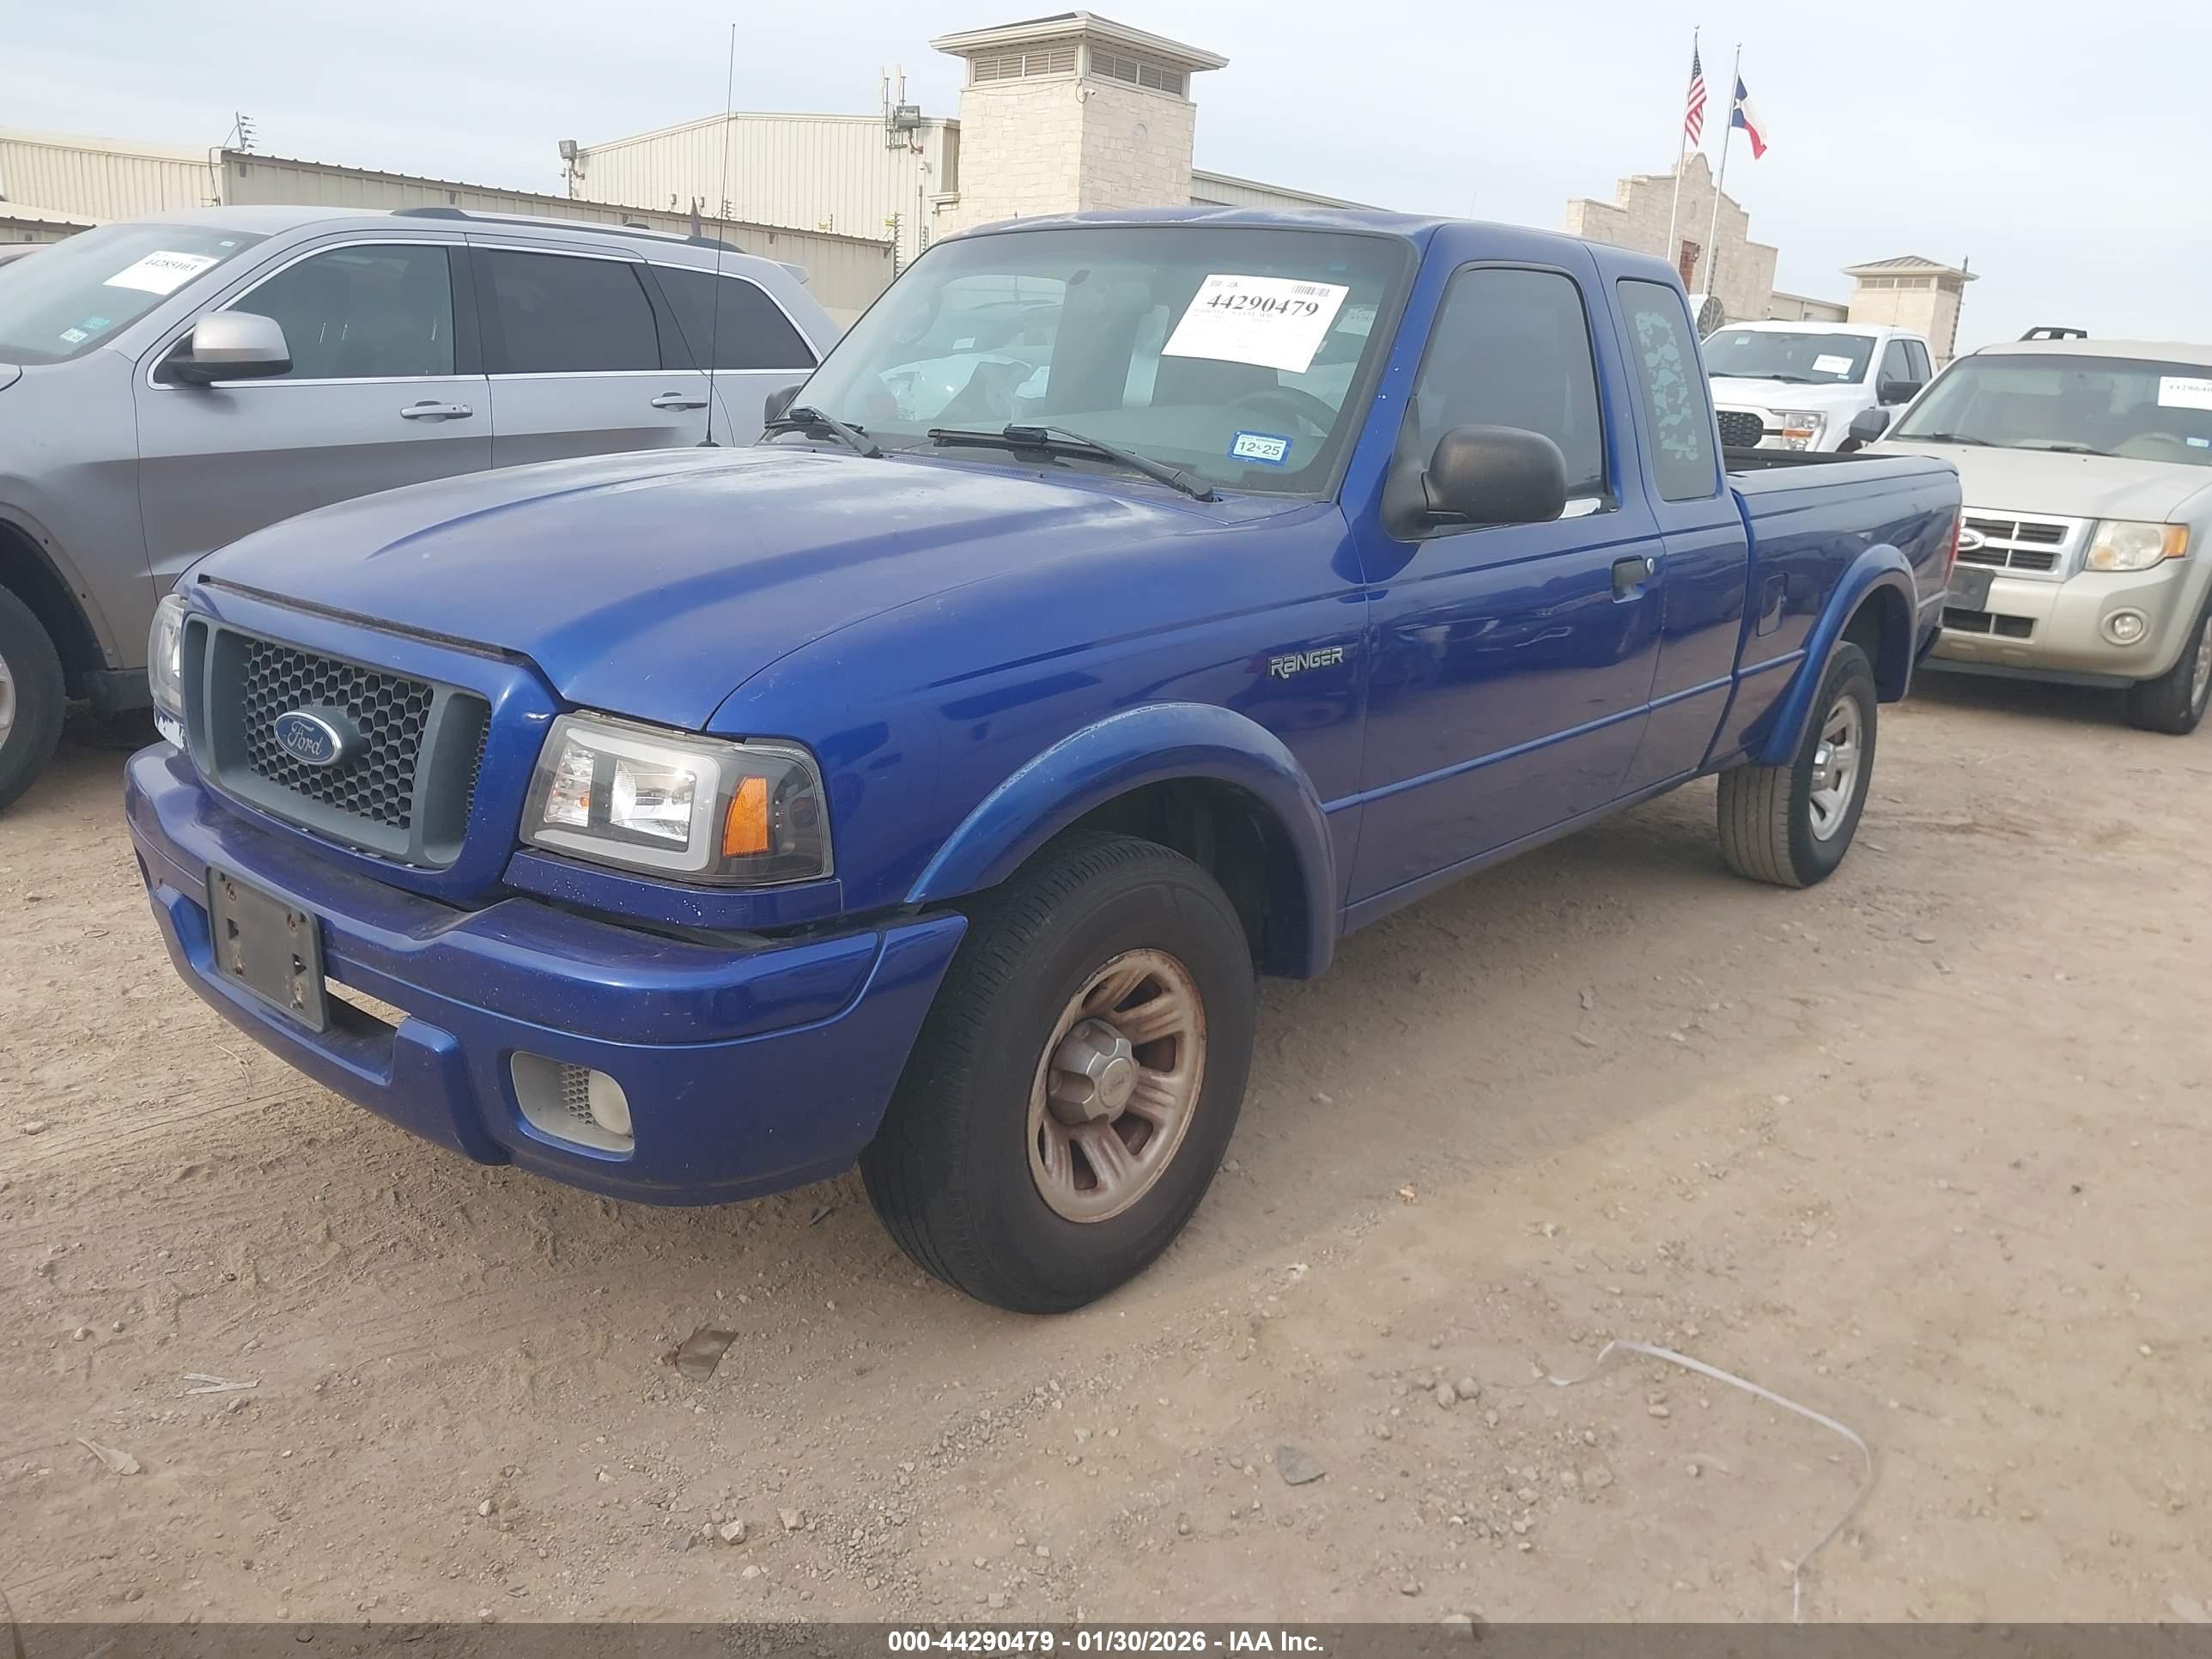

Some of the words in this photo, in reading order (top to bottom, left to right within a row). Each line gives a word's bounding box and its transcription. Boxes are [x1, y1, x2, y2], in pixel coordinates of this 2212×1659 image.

[1206, 294, 1320, 318] 44290479
[1239, 441, 1256, 453] 12
[1261, 445, 1281, 456] 25
[1270, 647, 1344, 679] RANGER
[287, 720, 324, 756] Ford
